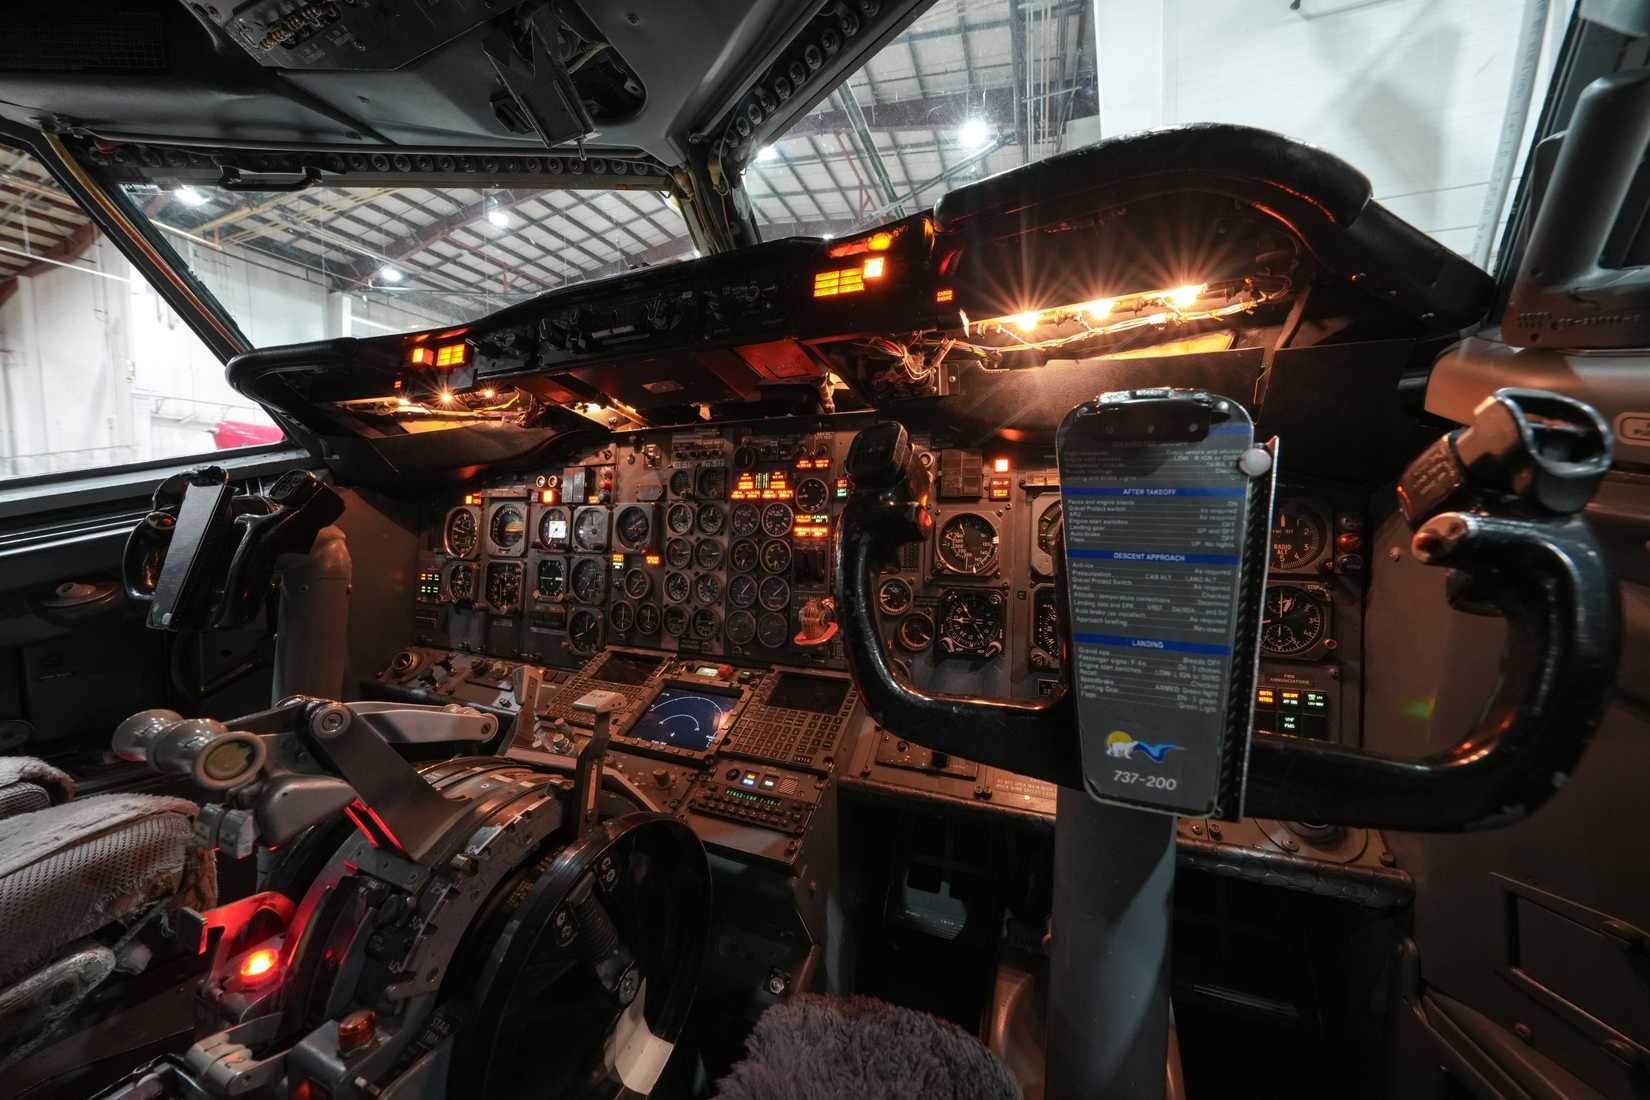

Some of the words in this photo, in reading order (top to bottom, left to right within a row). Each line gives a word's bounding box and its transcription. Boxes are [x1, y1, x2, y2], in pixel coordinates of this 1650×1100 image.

[1122, 488, 1145, 496] AFTER
[1146, 488, 1177, 496] TAKEOFF
[1113, 552, 1145, 561] DESCENT
[1145, 552, 1185, 562] APPROACH
[1131, 640, 1165, 649] LANDING
[1113, 769, 1177, 791] 737-200
